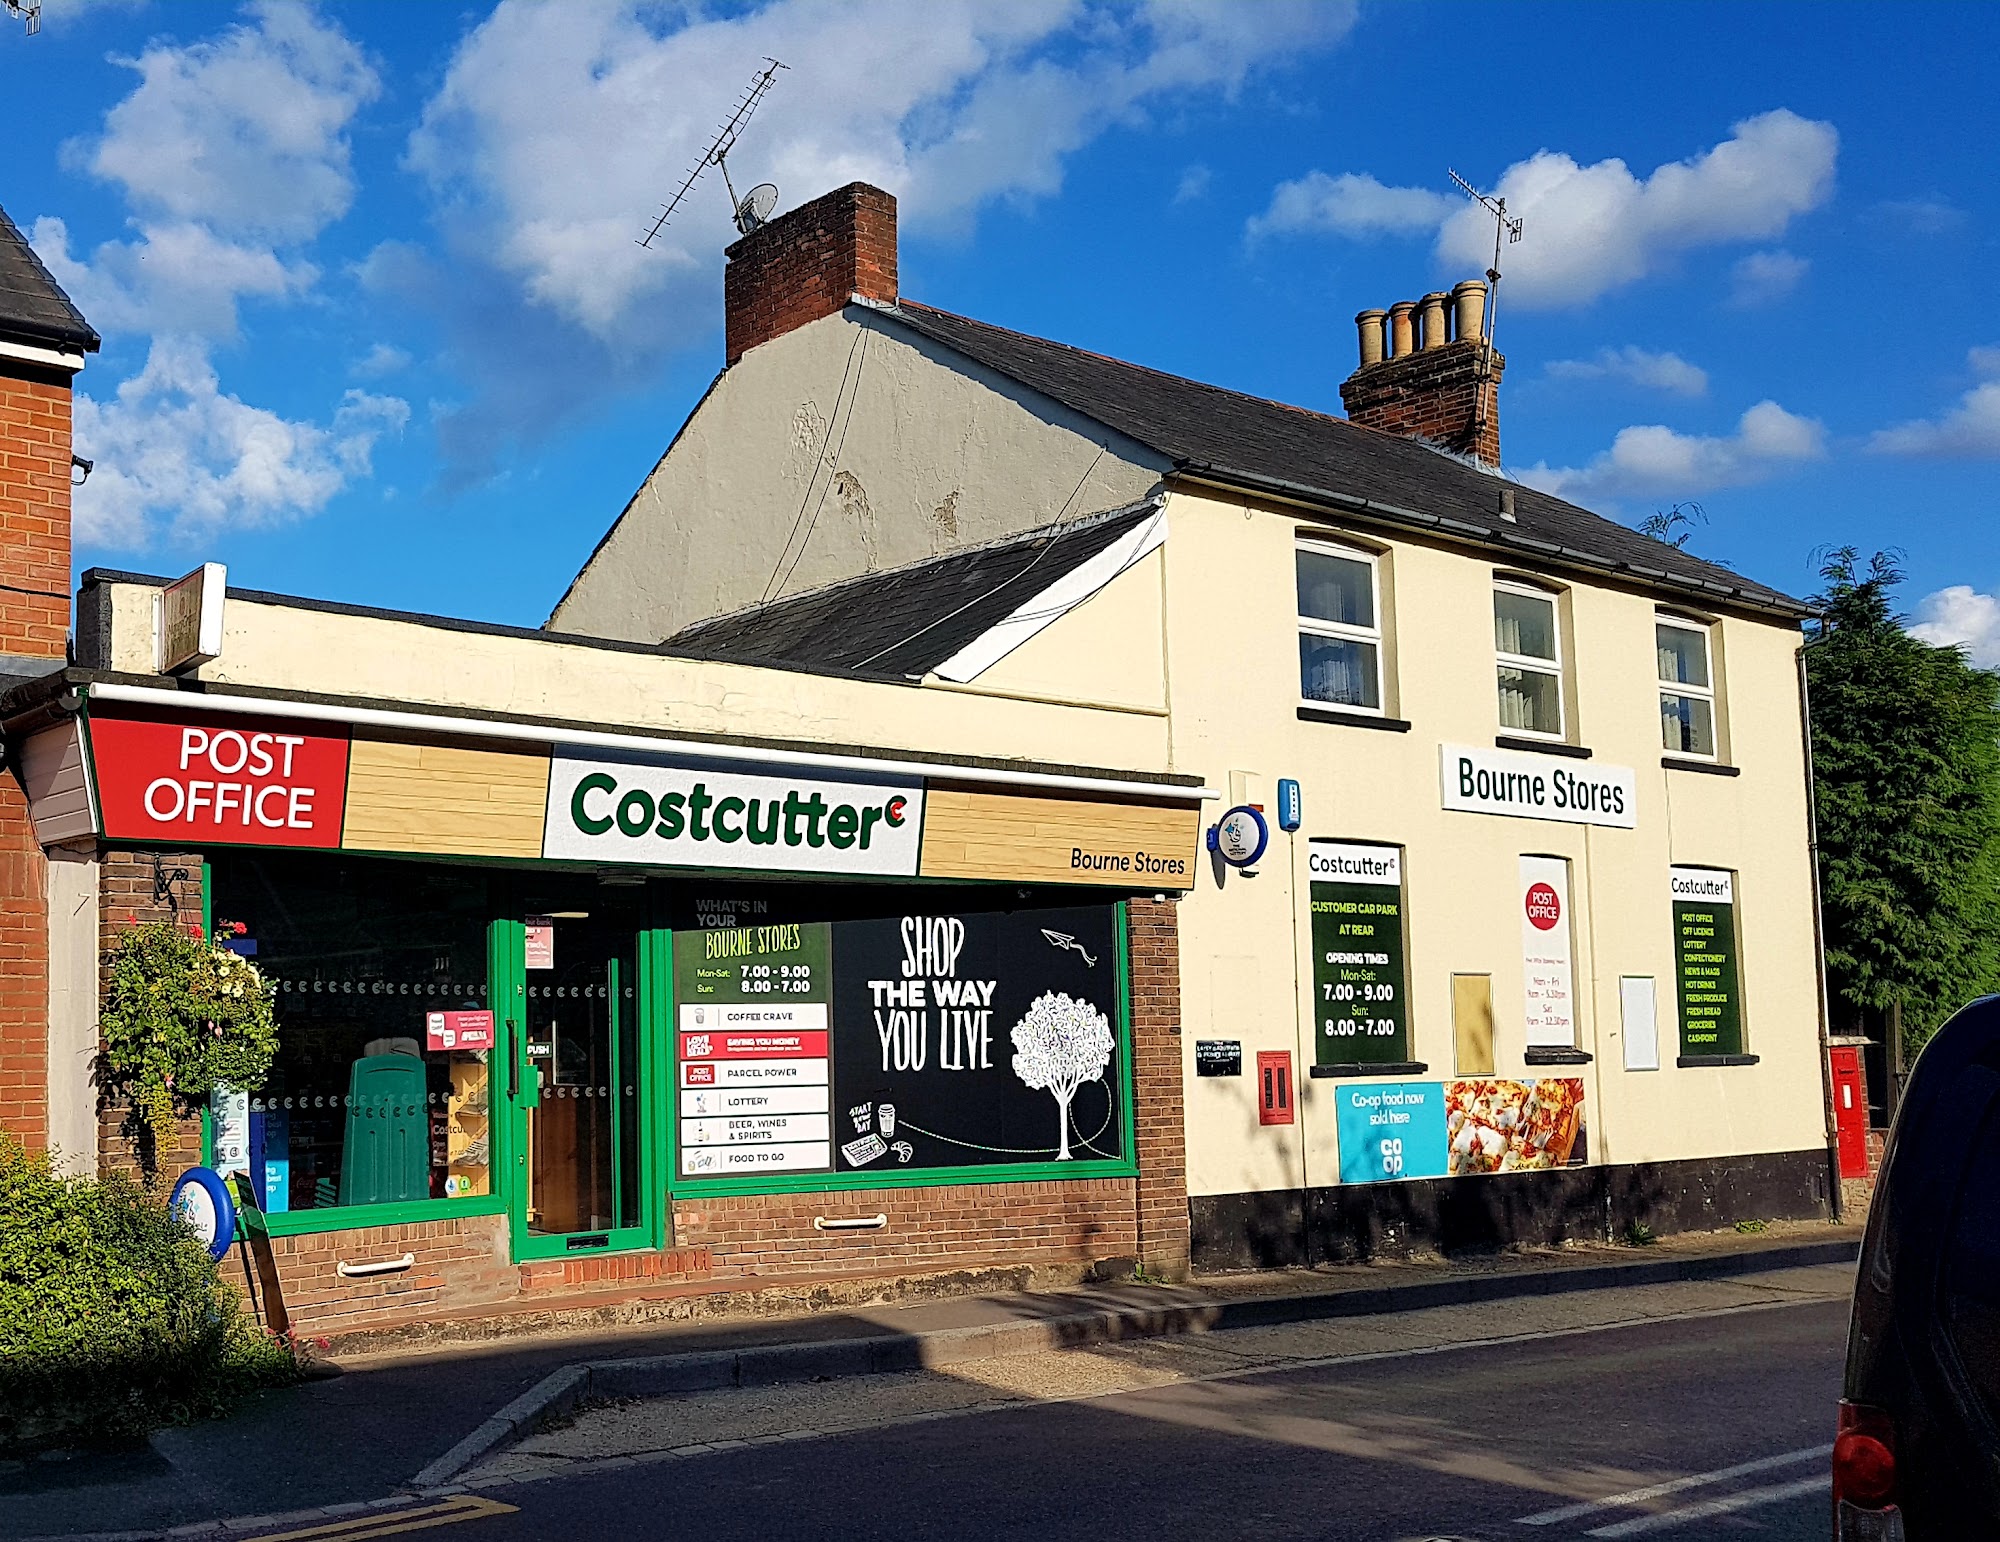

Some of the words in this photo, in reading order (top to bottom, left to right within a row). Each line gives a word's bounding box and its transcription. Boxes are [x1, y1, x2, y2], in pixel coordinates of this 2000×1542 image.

[179, 727, 304, 778] POST
[1459, 757, 1545, 806] Bourne
[1553, 769, 1624, 814] Stores
[144, 777, 315, 829] OFFICE
[570, 772, 884, 852] Costcutter
[1070, 847, 1130, 873] Bourne
[1135, 853, 1186, 875] Stores
[1309, 853, 1389, 876] Costcutter
[1671, 877, 1724, 896] Costcutter
[1532, 892, 1554, 905] POST
[696, 899, 750, 913] WHAT'S
[754, 901, 767, 913] IN
[1311, 901, 1357, 914] CUSTOMER
[1358, 903, 1375, 914] CAR
[1376, 904, 1398, 915] PARK
[1528, 905, 1558, 920] OFFICE
[696, 914, 736, 927] YOUR
[1682, 913, 1695, 922] POST
[1696, 914, 1713, 923] OFFICE
[1339, 924, 1351, 935] AT
[1352, 924, 1374, 935] REAR
[1683, 927, 1692, 935] OFF
[706, 928, 753, 960] BOURNE
[758, 924, 800, 953] STORES
[901, 916, 965, 977] SHOP
[1683, 940, 1706, 949] LOTTERY
[1326, 952, 1363, 964] OPENING
[1364, 953, 1389, 964] TIMES
[697, 969, 730, 978] Mon-Sat:
[741, 965, 770, 977] 7.00
[781, 965, 810, 977] 9.00
[1340, 969, 1376, 981] Mon-Sat:
[1685, 967, 1700, 975] NEWS
[697, 984, 714, 993] Sun:
[741, 980, 771, 993] 8.00
[781, 980, 810, 993] 7.00
[1685, 981, 1696, 989] HOT
[868, 980, 926, 1007] THE
[932, 980, 997, 1007] WAY
[1323, 984, 1354, 1000] 7.00
[1364, 984, 1393, 1001] 9.00
[1686, 994, 1702, 1002] FRESH
[1703, 994, 1727, 1002] PRODUCE
[727, 1013, 761, 1021] COFFEE
[763, 1012, 793, 1020] CRAVE
[1351, 1004, 1369, 1016] Sun:
[1686, 1007, 1703, 1015] FRESH
[1325, 1019, 1356, 1036] 8.00
[1365, 1019, 1394, 1035] 7.00
[755, 1037, 771, 1046] YOU
[873, 1009, 927, 1071] YOU
[940, 1009, 993, 1071] LIVE
[1687, 1034, 1717, 1043] CASHPOINT
[527, 1045, 549, 1055] PUSH
[728, 1069, 762, 1078] PARCEL
[765, 1068, 796, 1077] POWER
[728, 1097, 768, 1106] LOTTERY
[1351, 1092, 1381, 1110] Co-op
[1382, 1090, 1404, 1105] food
[1405, 1093, 1425, 1104] now
[1369, 1109, 1388, 1125] sold
[1389, 1109, 1410, 1124] here
[729, 1120, 755, 1129] BEER,
[758, 1119, 787, 1127] WINES
[729, 1132, 735, 1140] &
[738, 1131, 772, 1140] SPIRITS
[729, 1154, 754, 1163] FOOD
[772, 1153, 784, 1161] GO
